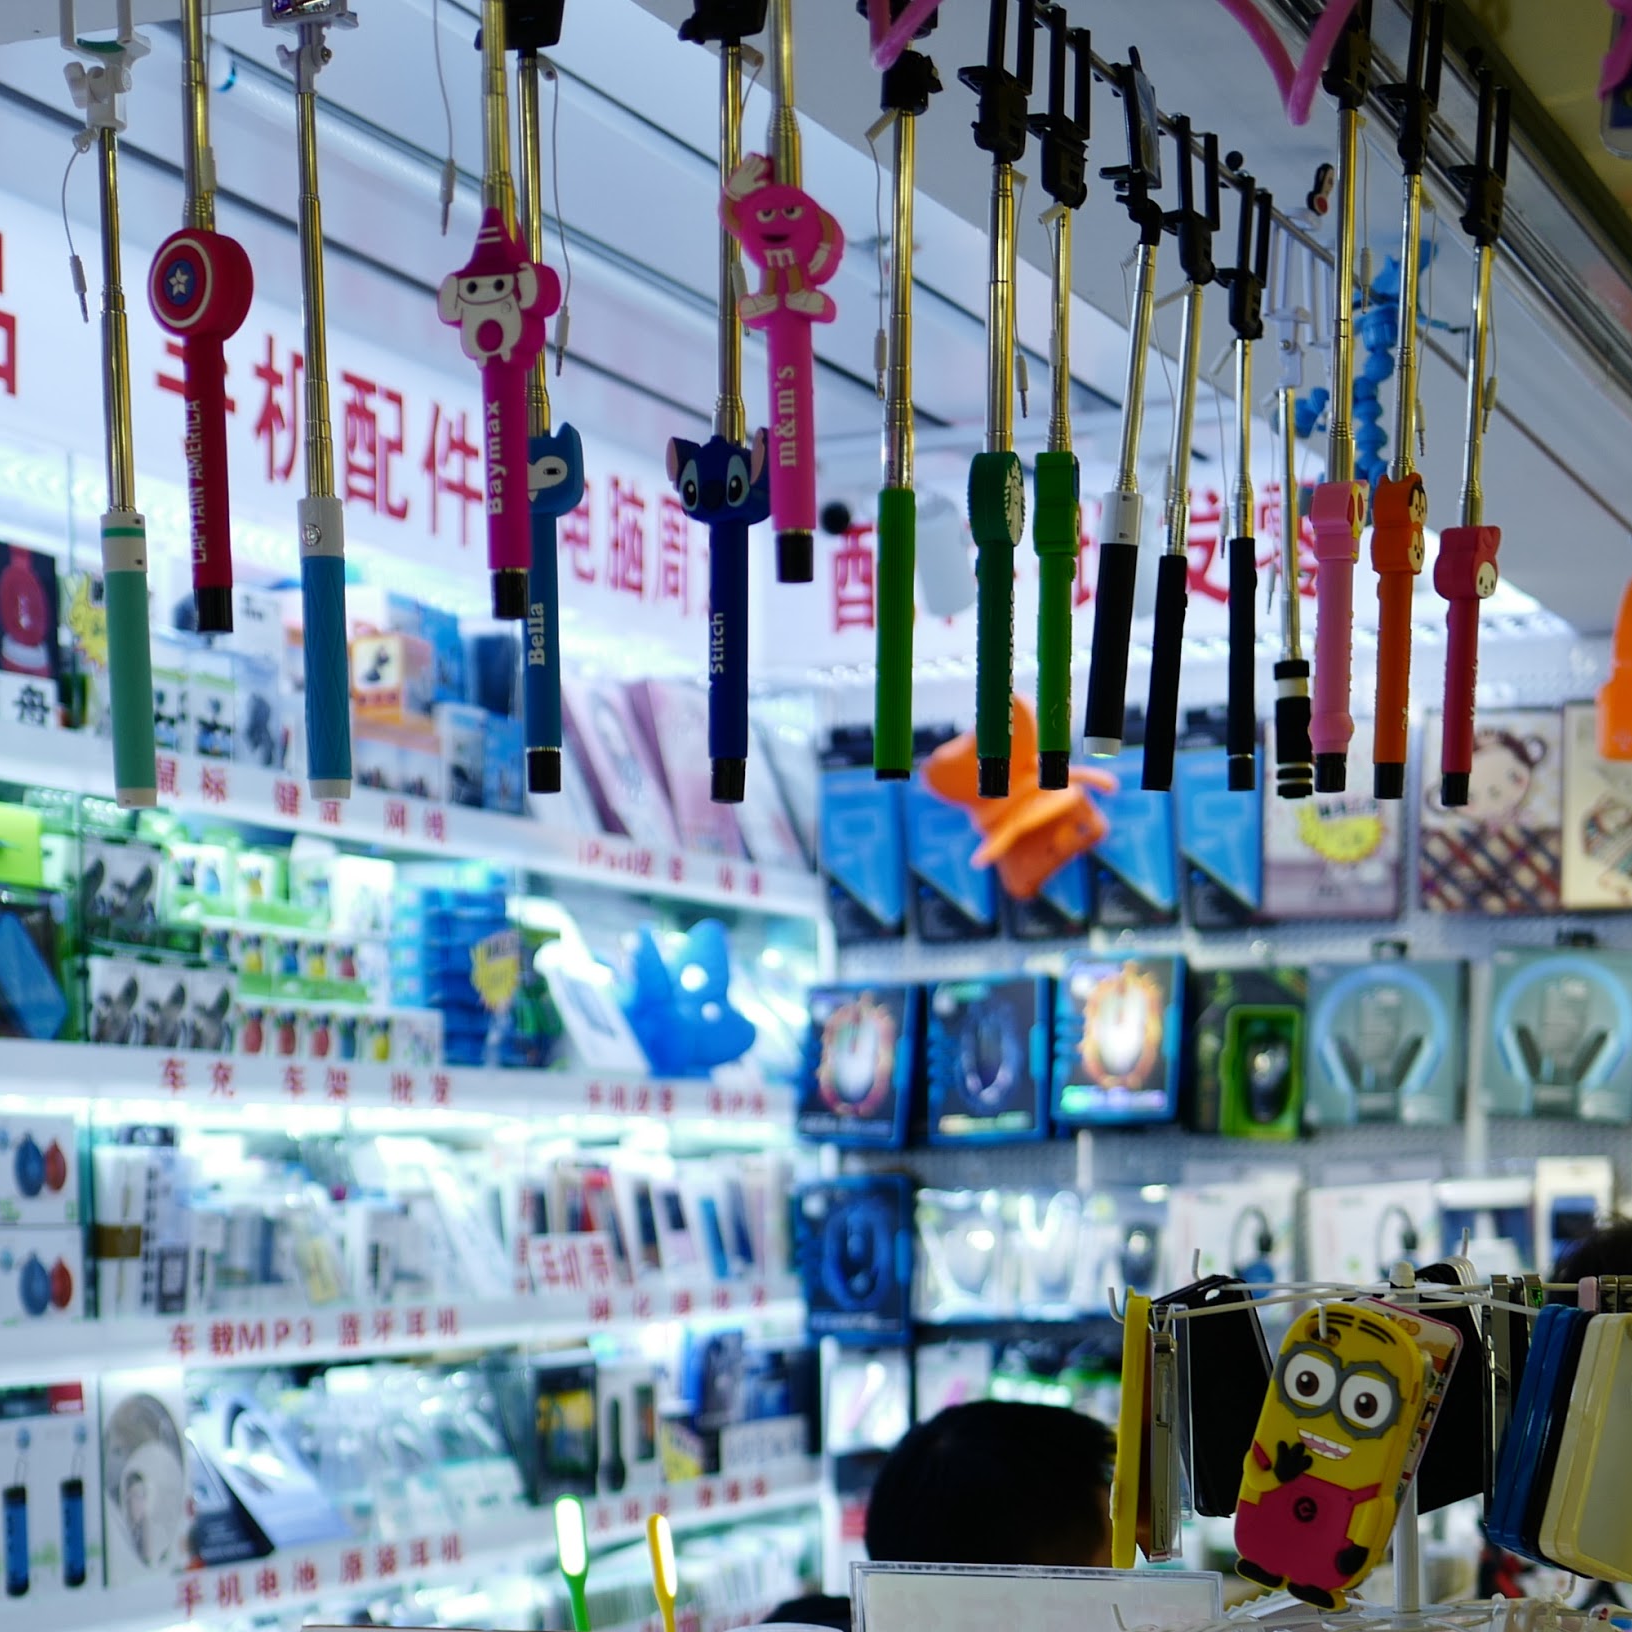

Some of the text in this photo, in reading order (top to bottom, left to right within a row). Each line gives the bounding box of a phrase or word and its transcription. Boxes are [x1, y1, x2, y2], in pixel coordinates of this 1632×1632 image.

[186, 400, 207, 564] CAPTAIN AMERICA
[486, 401, 504, 514] Baymax
[561, 474, 711, 618] 电脑周
[527, 603, 547, 666] Bella
[710, 612, 725, 674] Stitch
